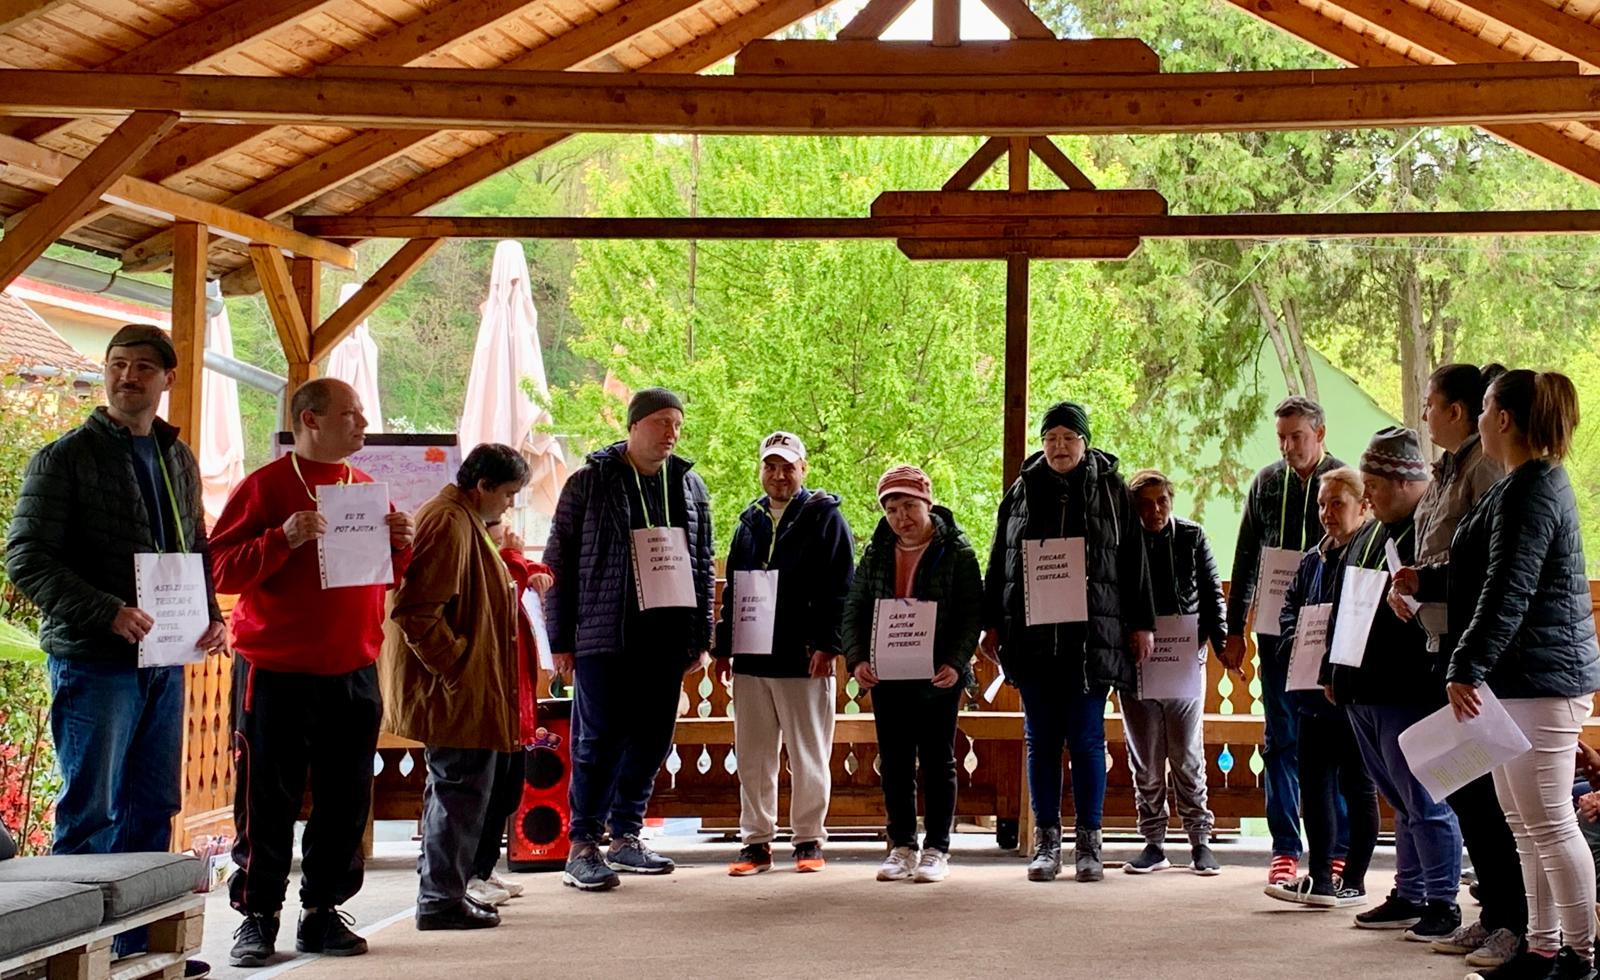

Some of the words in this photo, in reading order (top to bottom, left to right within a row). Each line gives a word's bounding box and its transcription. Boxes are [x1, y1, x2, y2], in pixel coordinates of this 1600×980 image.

[765, 433, 791, 448] UFC
[334, 525, 350, 533] POT
[1039, 553, 1066, 561] FIECARE
